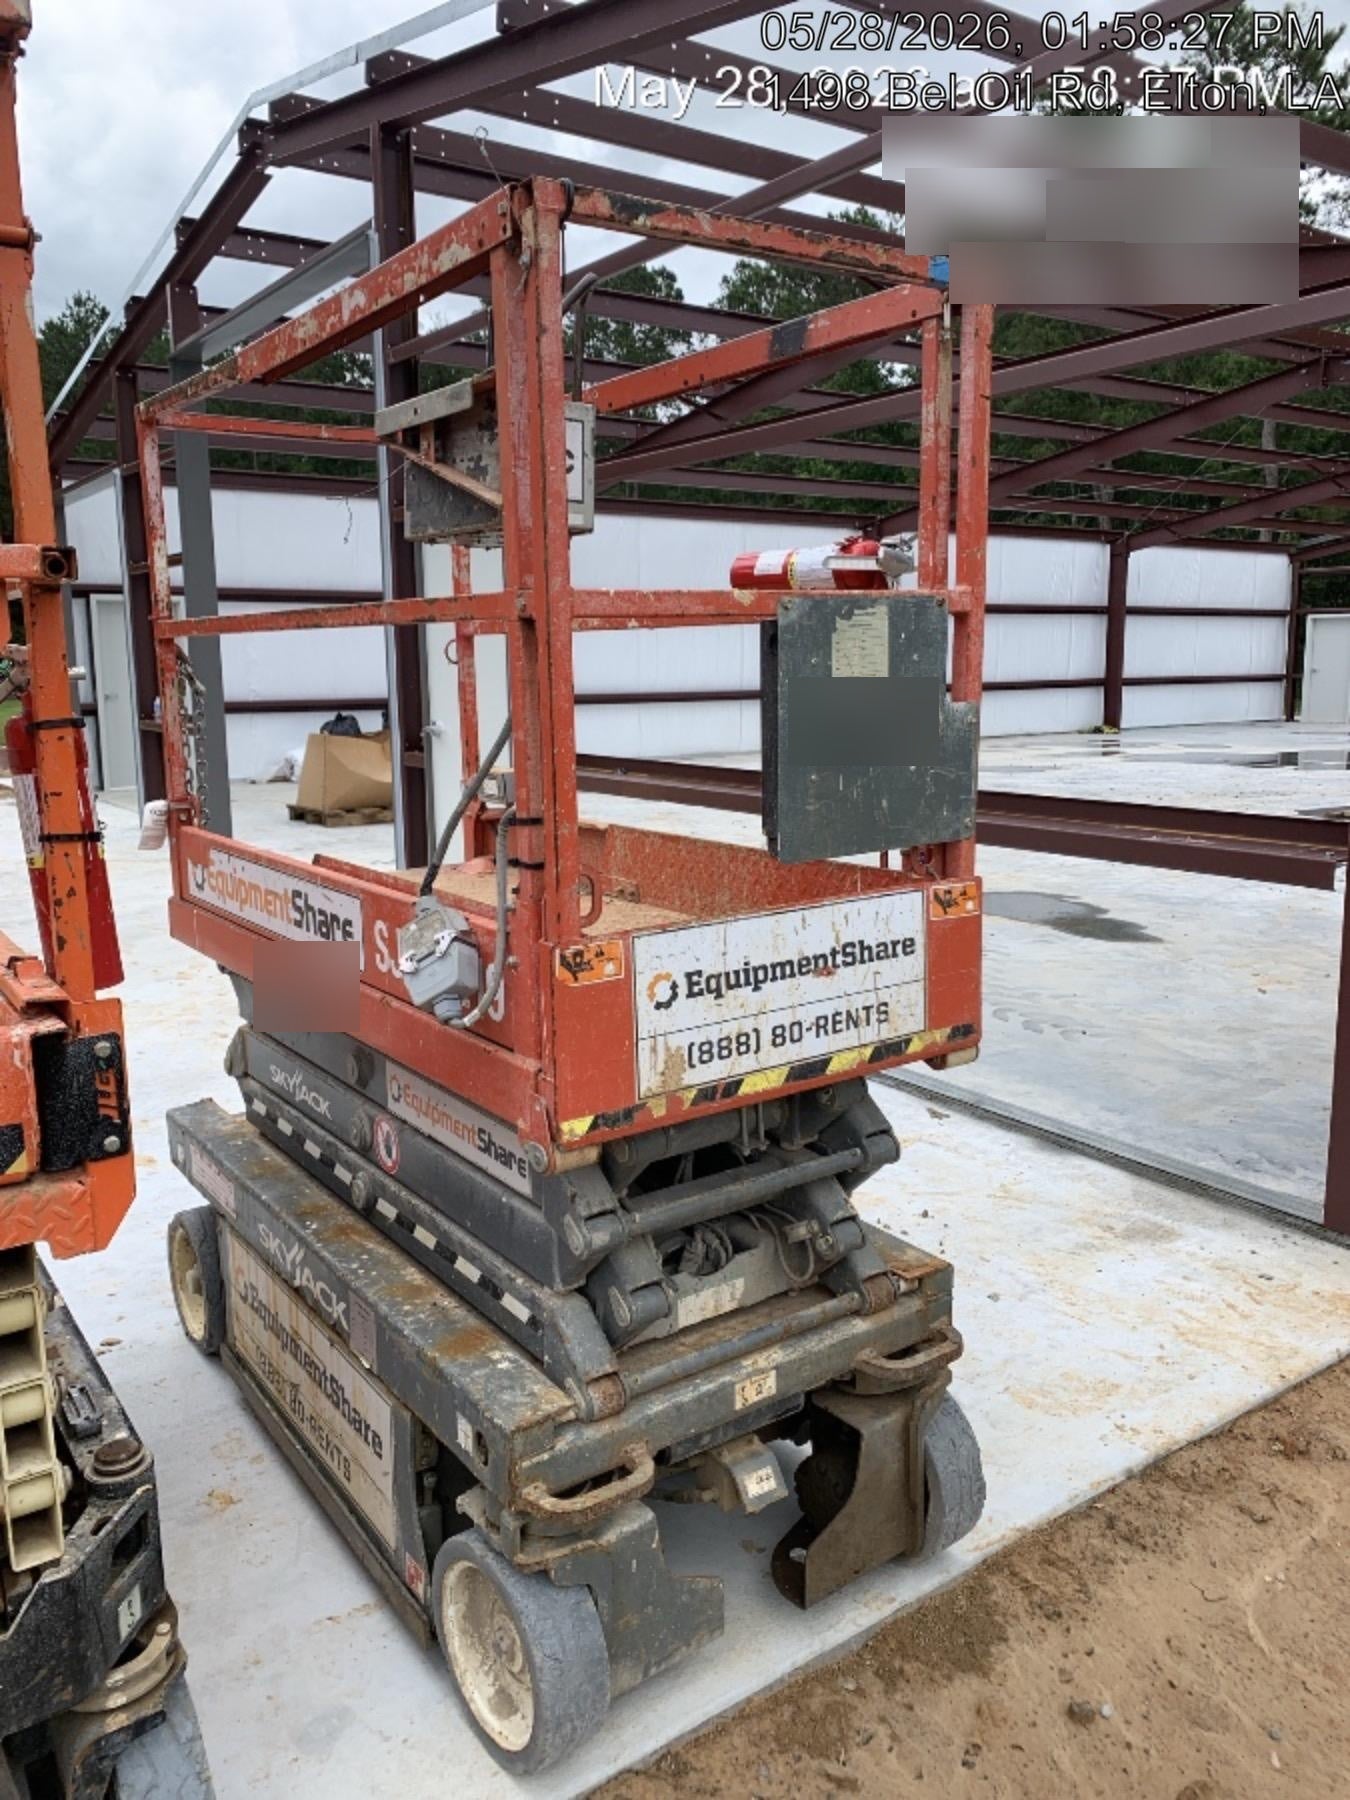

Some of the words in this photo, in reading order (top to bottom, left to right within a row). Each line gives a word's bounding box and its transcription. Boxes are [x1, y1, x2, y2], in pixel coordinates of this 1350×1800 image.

[207, 866, 354, 941] EquipmentShare
[685, 937, 916, 1000] EquipmentShare
[687, 1028, 761, 1069] (888)
[771, 1002, 890, 1048] 80-RENTS
[402, 1084, 528, 1178] EquipmentShare
[258, 1223, 349, 1331] SKYJACK
[249, 1283, 383, 1460] EquipmentShare
